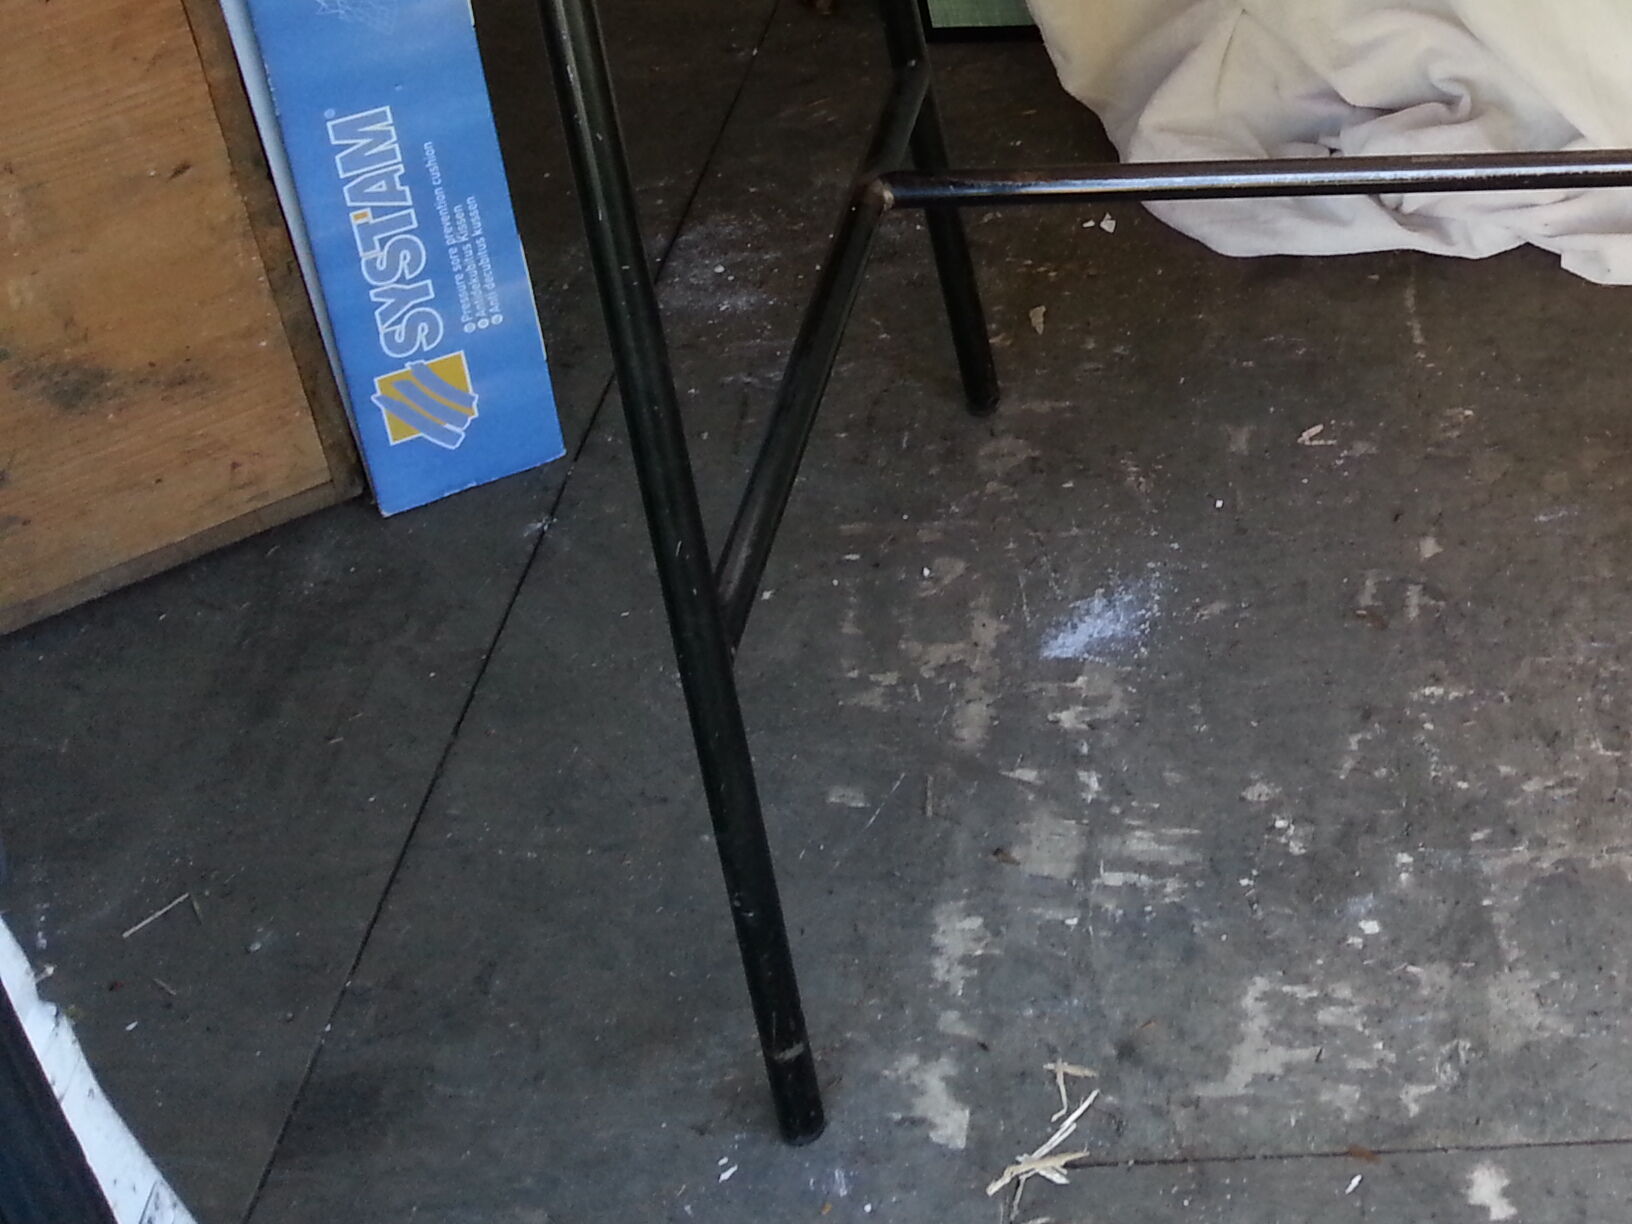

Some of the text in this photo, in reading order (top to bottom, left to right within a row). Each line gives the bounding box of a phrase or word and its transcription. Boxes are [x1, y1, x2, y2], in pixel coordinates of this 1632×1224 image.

[326, 105, 444, 358] SYSTAM
[423, 140, 472, 323] Pressure sore prevention cushion
[453, 204, 487, 317] Antidekubitus Kissen
[476, 236, 496, 292] decubitus
[487, 290, 500, 313] Anti
